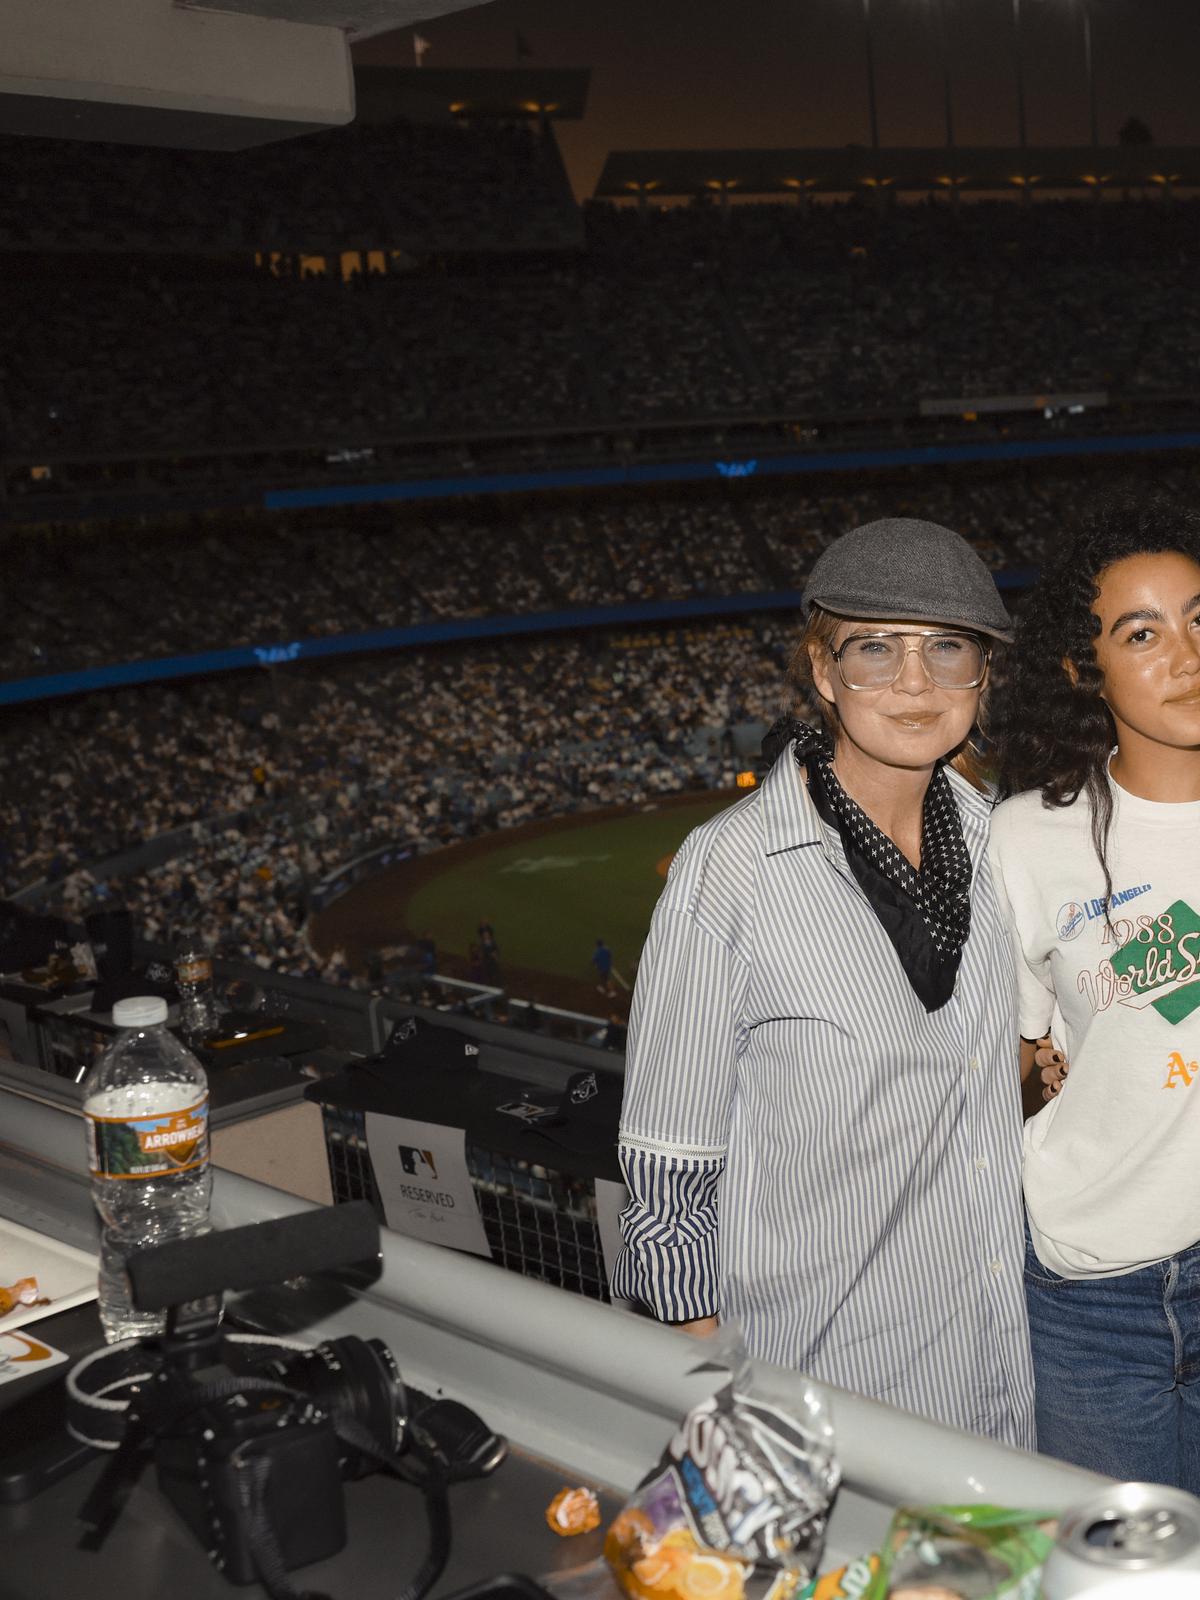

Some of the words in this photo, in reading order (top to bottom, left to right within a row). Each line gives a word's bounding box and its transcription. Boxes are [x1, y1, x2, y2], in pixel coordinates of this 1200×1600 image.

[1110, 883, 1152, 909] ANGELES
[1100, 913, 1176, 948] 1988
[1076, 946, 1177, 1017] World
[399, 1184, 456, 1209] RESERVED
